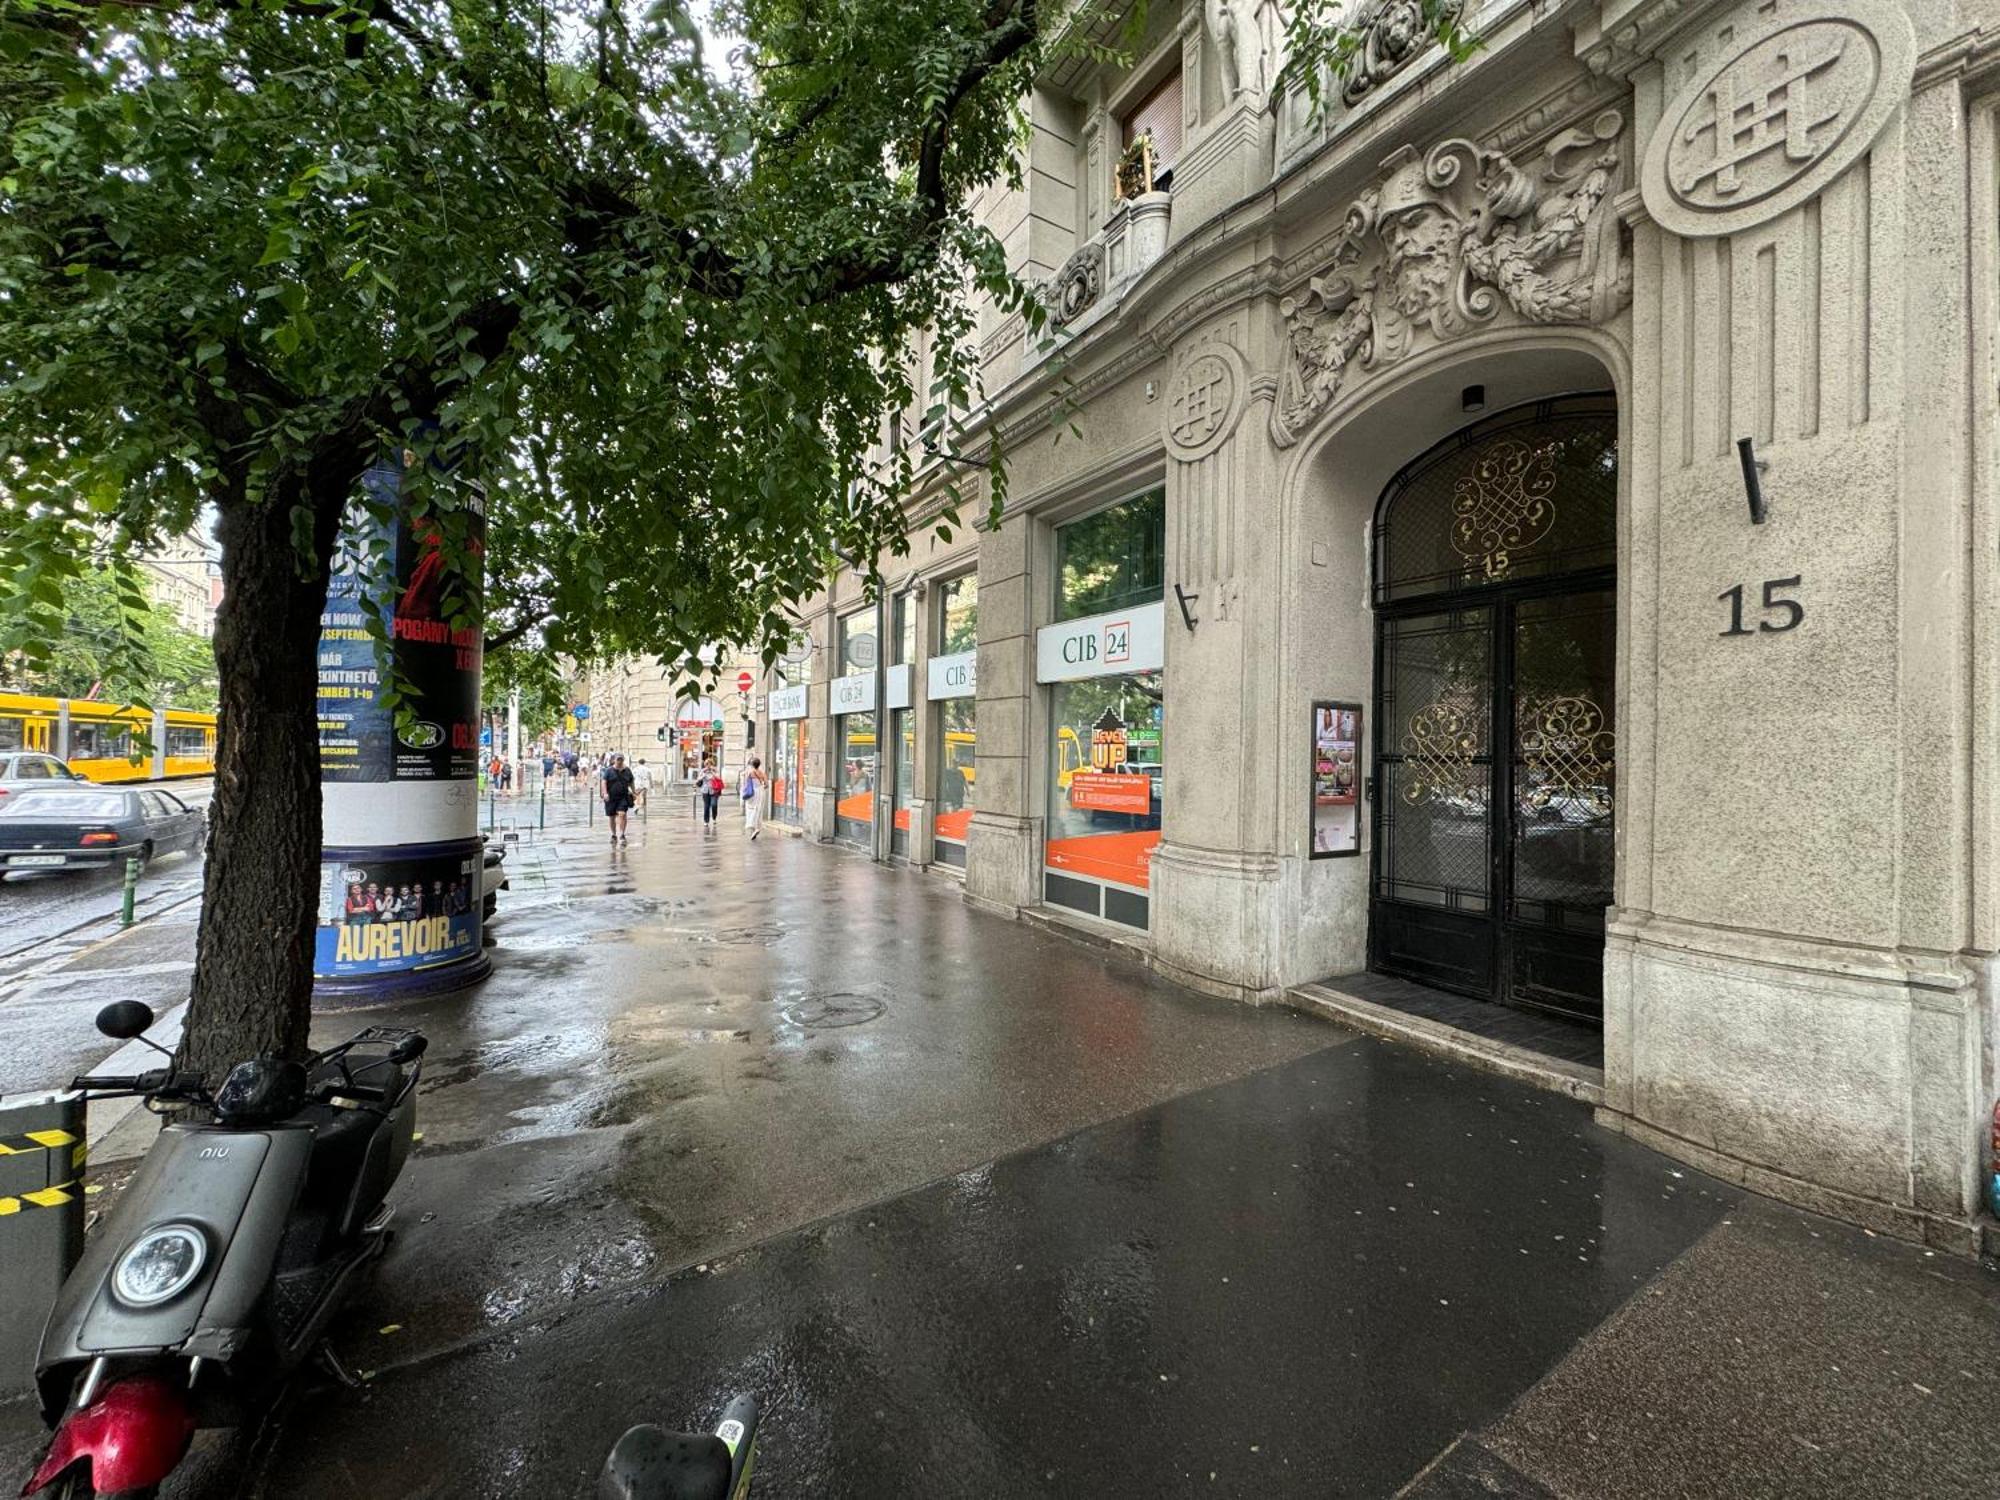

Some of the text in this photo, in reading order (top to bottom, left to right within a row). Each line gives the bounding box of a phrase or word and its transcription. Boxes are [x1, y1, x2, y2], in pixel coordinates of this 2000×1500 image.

[1480, 550, 1508, 572] 15
[1717, 574, 1804, 636] 15
[333, 612, 361, 627] NOW
[1063, 631, 1127, 663] CIB 24
[320, 652, 343, 666] MÁR
[946, 664, 966, 686] CIB
[1093, 730, 1125, 743] LEVEL
[1093, 744, 1125, 769] UP
